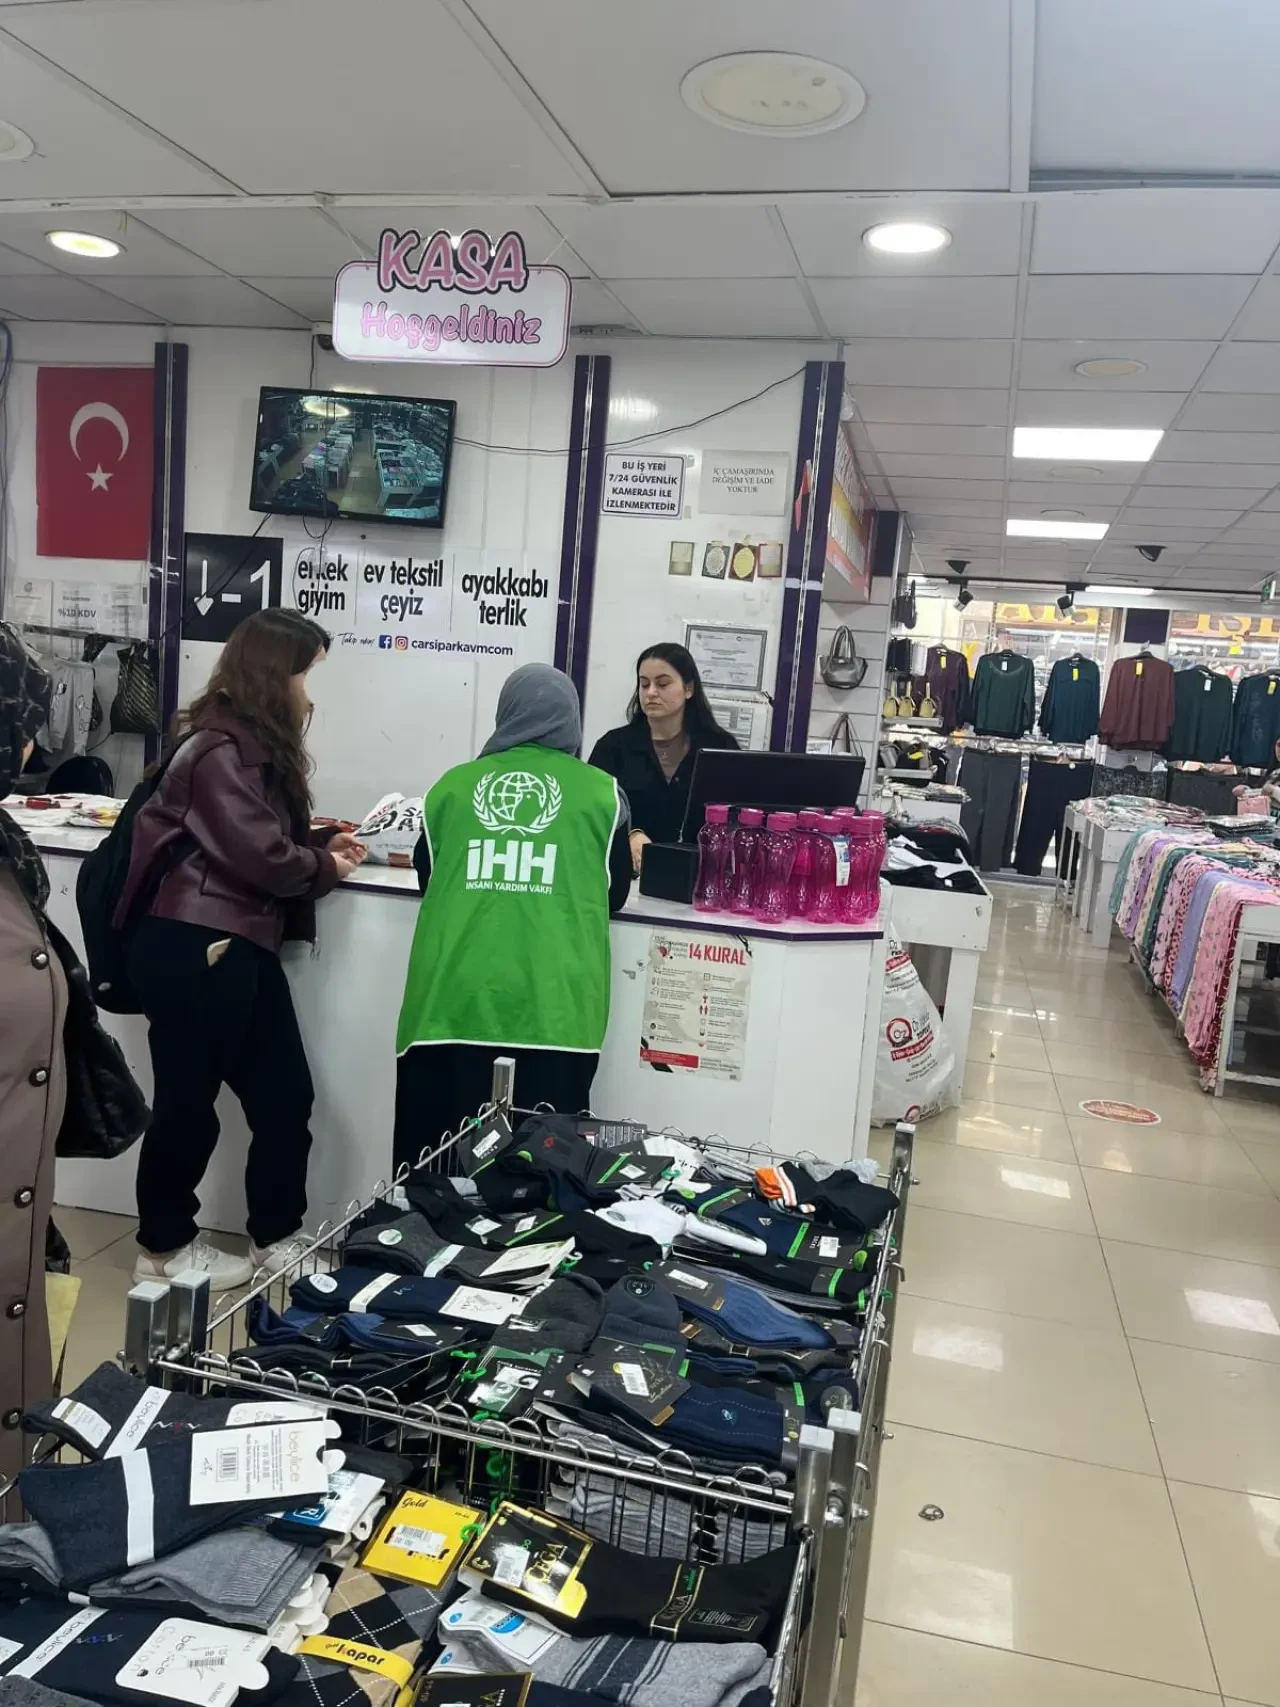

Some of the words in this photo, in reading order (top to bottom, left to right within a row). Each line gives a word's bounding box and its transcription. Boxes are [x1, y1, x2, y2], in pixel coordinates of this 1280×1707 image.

[378, 228, 529, 295] KASA
[360, 301, 542, 351] Hoşgeldiniz
[621, 460, 636, 471] BU
[647, 461, 667, 472] YERİ
[608, 473, 629, 484] 7/24
[631, 473, 678, 486] GÜVENLİK
[611, 486, 657, 498] KAMERASI
[658, 487, 672, 499] İLE
[606, 499, 676, 512] İZLENMEKTEDİR
[363, 562, 386, 583] ev
[390, 557, 444, 587] tekstil
[461, 566, 549, 601] ayakkabı
[298, 582, 346, 616] giyim
[380, 588, 424, 622] çeyiz
[479, 598, 528, 627] terlik
[494, 882, 528, 893] YARDIM
[688, 942, 702, 961] 14
[703, 944, 747, 966] KURAL
[401, 1497, 429, 1509] Gold
